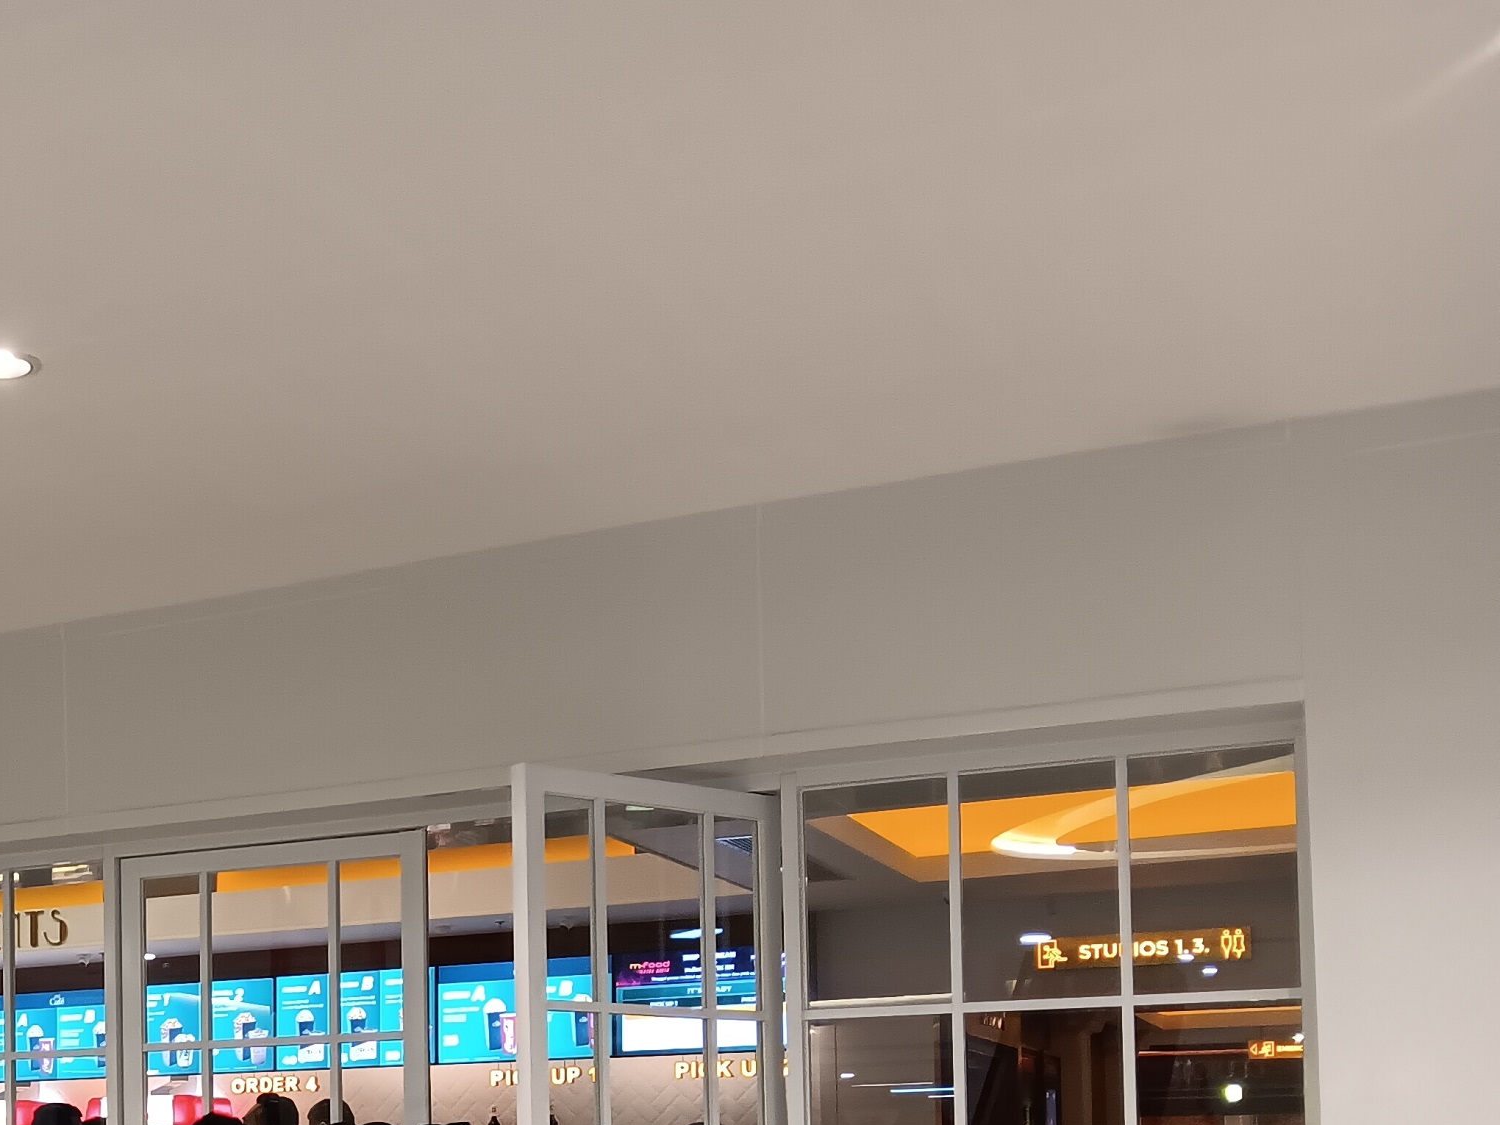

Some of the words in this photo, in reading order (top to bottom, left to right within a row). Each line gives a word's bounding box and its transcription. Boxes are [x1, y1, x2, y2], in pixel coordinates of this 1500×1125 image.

[1078, 940, 1169, 960] STUIOS
[231, 1076, 301, 1095] ORDER
[305, 1075, 320, 1093] 4
[551, 1066, 583, 1085] UP
